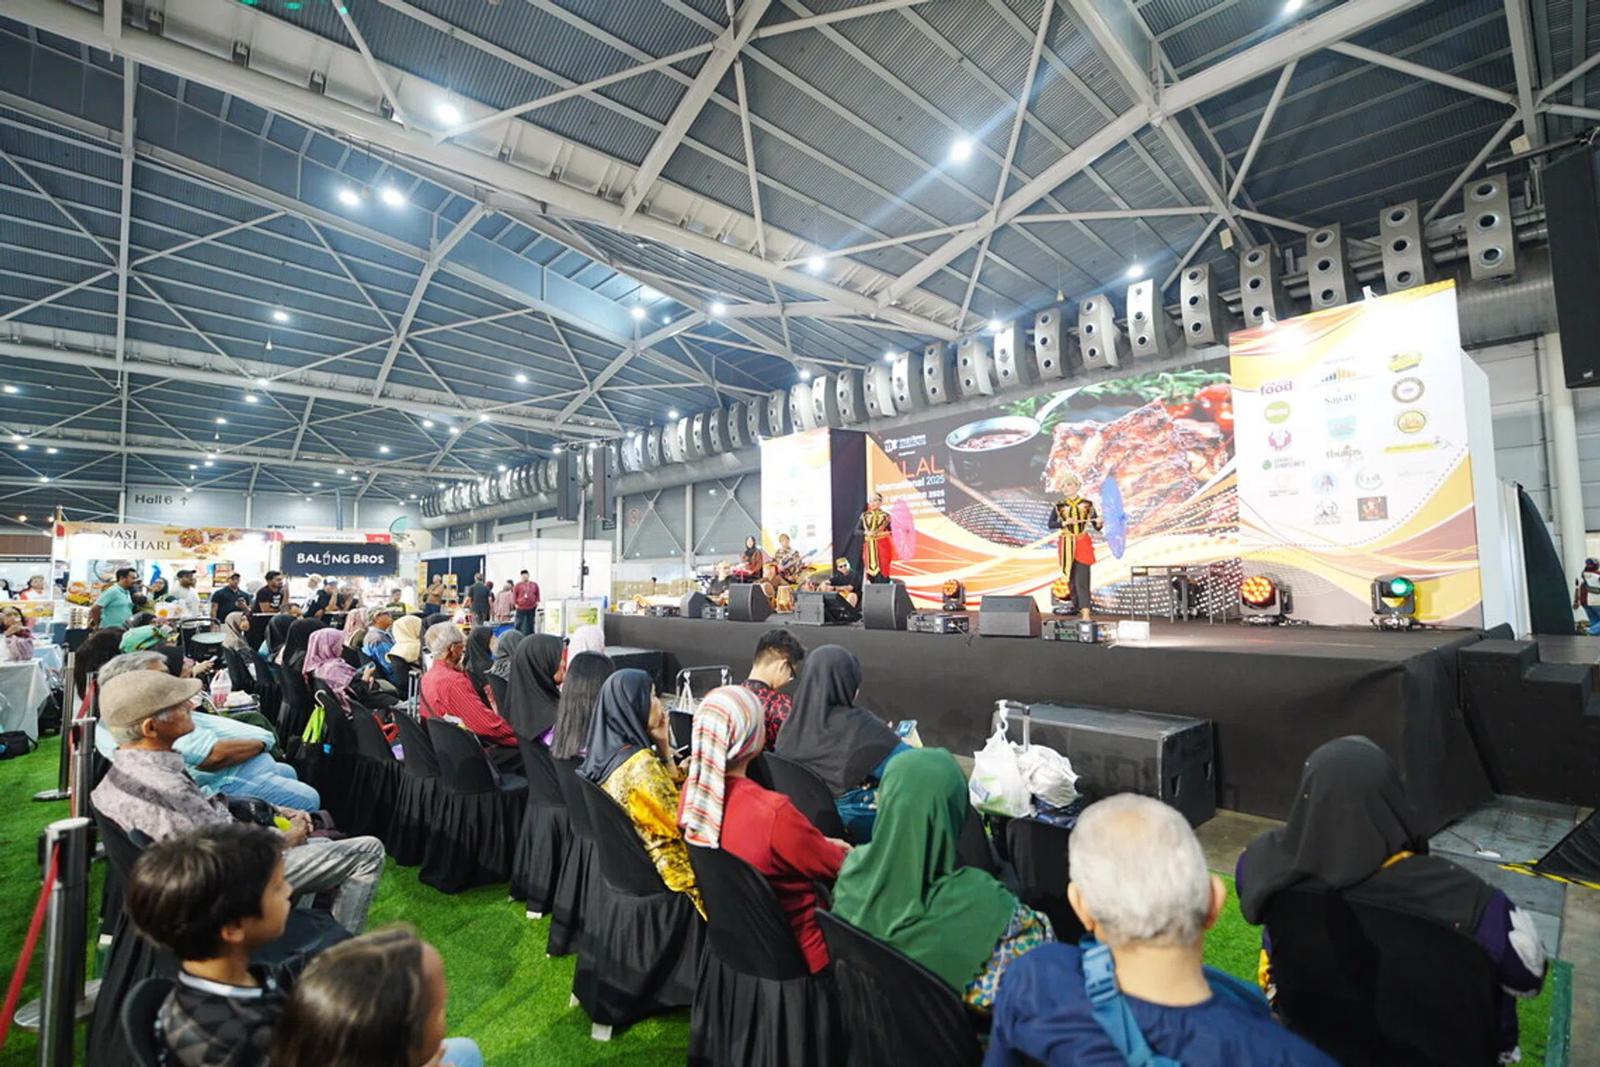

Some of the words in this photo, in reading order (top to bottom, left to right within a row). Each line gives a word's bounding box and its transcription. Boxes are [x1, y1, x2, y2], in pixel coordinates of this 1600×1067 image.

[1260, 380, 1293, 396] food
[135, 494, 162, 504] Hall
[164, 495, 173, 504] 6
[102, 530, 138, 540] NASI
[353, 553, 385, 564] BROS
